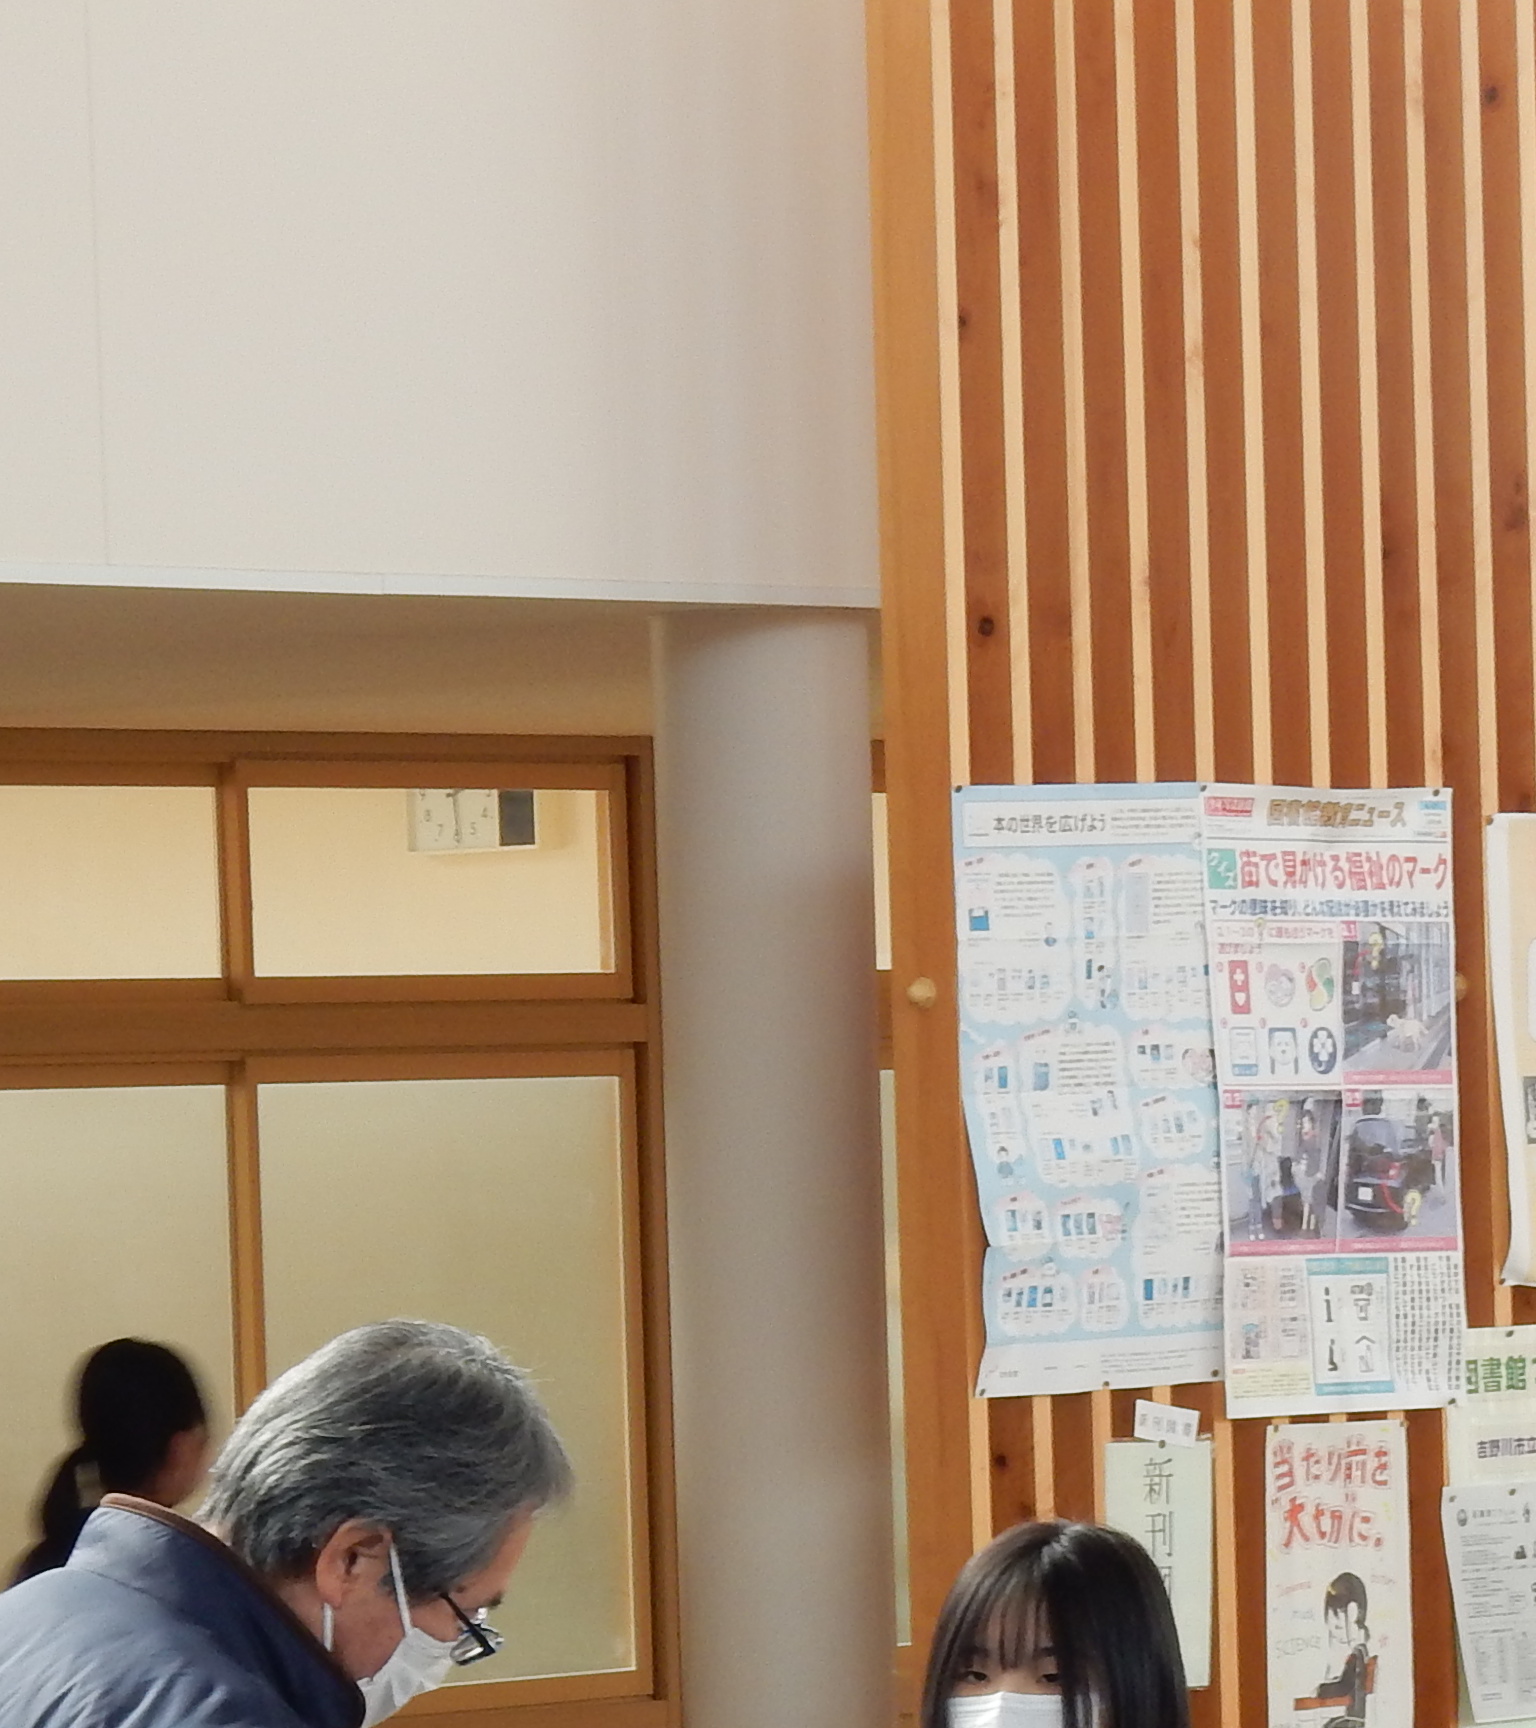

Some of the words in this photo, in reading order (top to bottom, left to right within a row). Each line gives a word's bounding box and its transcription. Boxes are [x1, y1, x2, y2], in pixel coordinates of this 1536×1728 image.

[993, 813, 1106, 834] 本の世界を広げよう
[1239, 849, 1448, 891] 街で見かける福祉のマーク
[1272, 1437, 1390, 1492] 当たり前を
[1282, 1496, 1384, 1550] 大切に。
